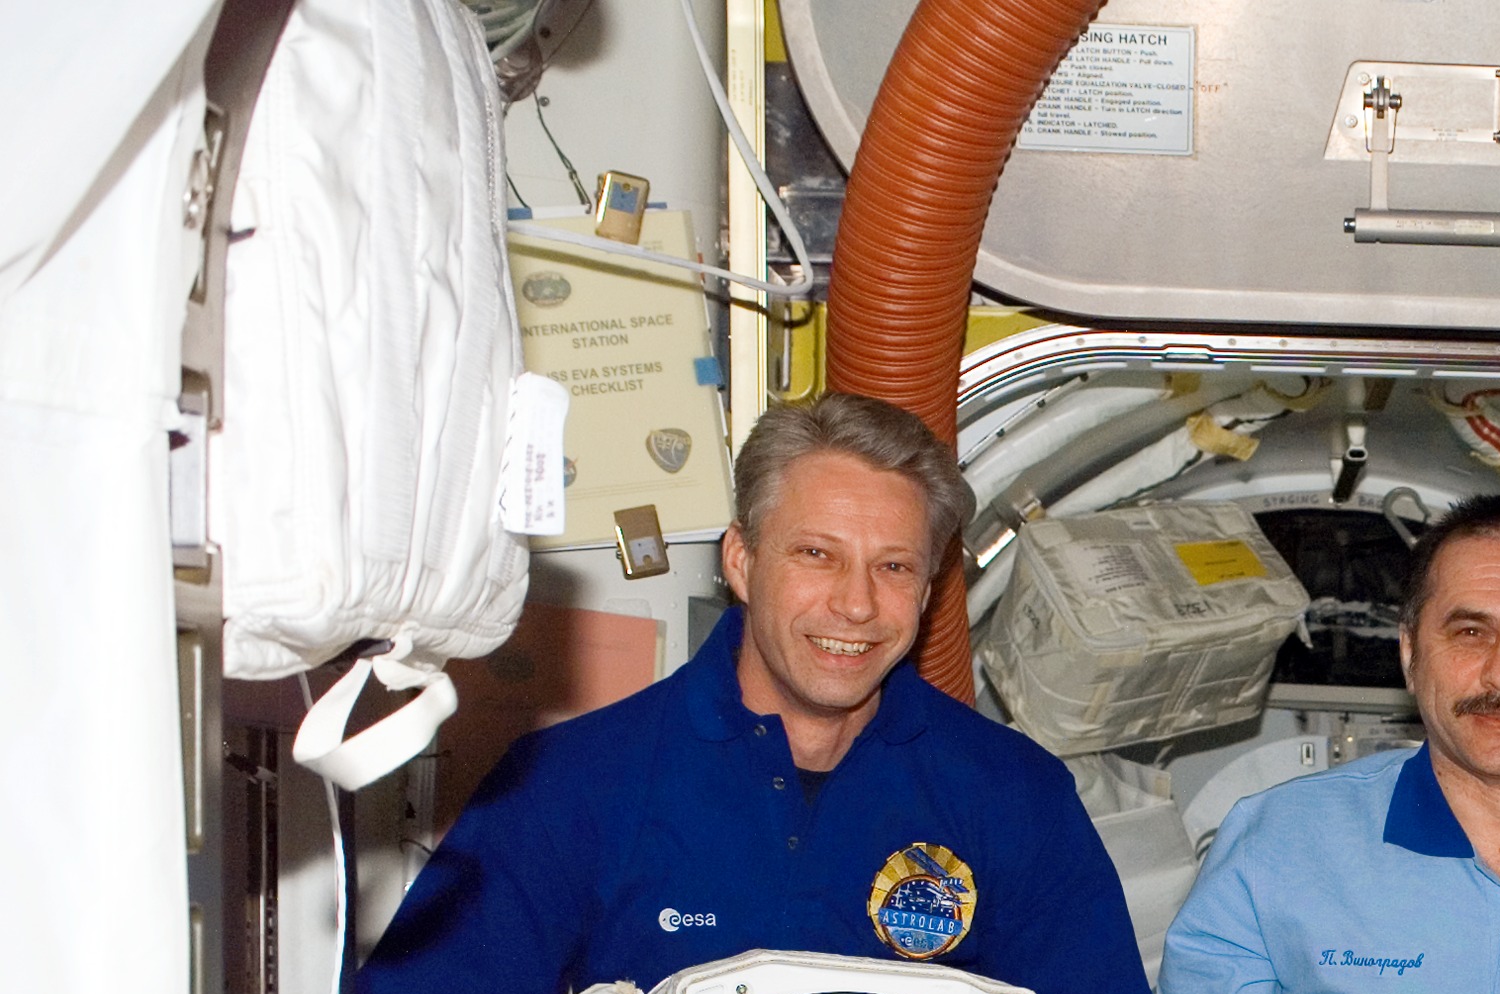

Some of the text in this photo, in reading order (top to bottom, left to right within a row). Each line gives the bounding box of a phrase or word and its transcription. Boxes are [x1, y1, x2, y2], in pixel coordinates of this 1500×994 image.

[1080, 32, 1167, 46] SING HATCH
[521, 313, 674, 338] NTERNATIONAL SPACE
[571, 334, 629, 349] STATION
[571, 366, 599, 381] EVA
[601, 361, 663, 378] SYSTEMS
[571, 379, 644, 397] CHECKLIST
[1263, 493, 1319, 507] STAGING
[881, 910, 957, 934] ASTROLAB
[1318, 949, 1425, 976] П. Виноградов
